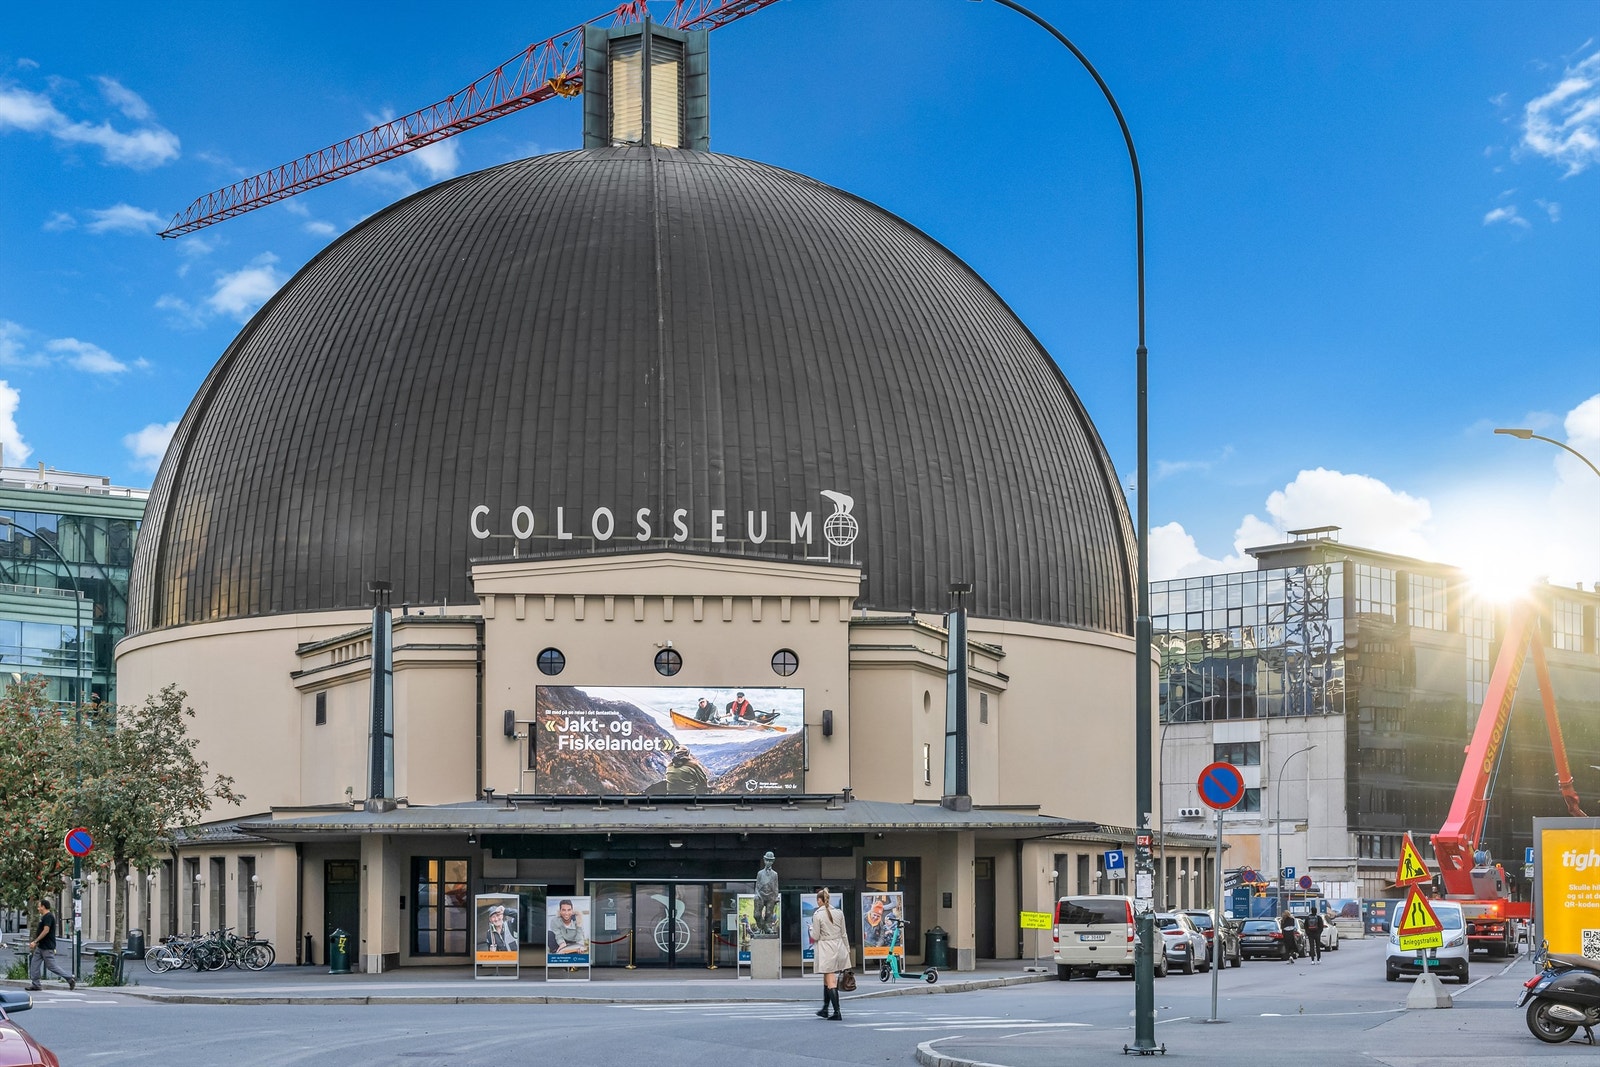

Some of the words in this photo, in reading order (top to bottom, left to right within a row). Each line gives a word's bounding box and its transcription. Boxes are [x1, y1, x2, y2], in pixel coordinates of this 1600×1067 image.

[470, 504, 813, 545] COLOSSEUM
[609, 720, 632, 736] og
[1108, 853, 1119, 867] P
[1287, 868, 1293, 878] P
[1403, 936, 1439, 946] Anleggstrafikk
